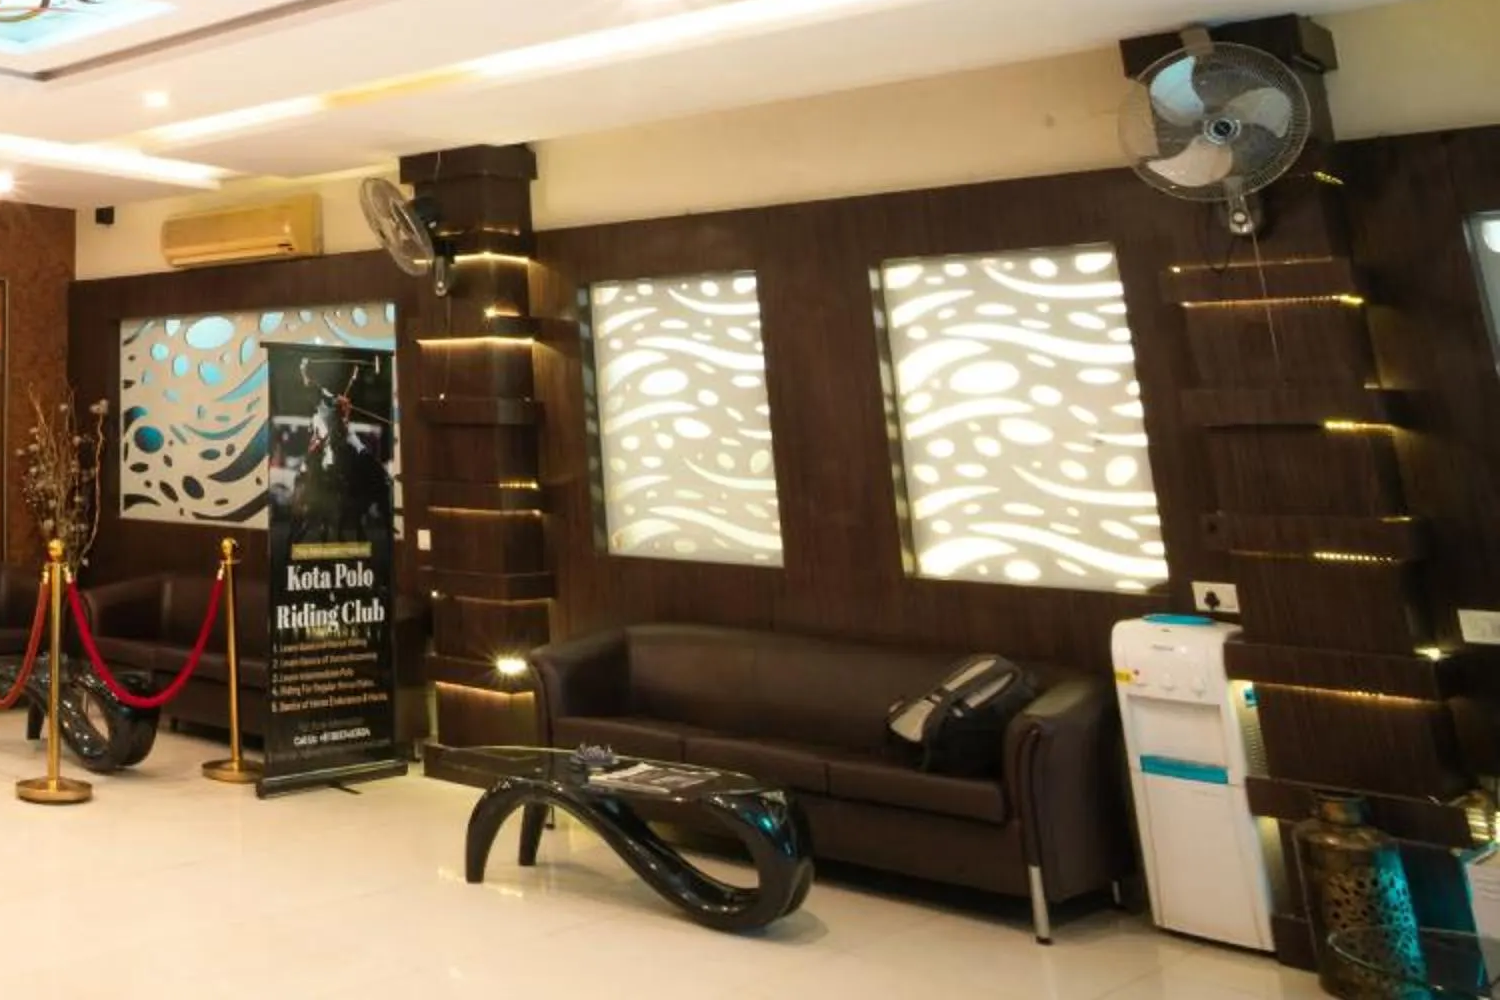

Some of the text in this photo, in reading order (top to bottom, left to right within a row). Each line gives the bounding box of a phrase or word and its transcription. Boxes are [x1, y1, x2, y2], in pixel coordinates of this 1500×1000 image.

[286, 560, 374, 591] Kota Polo
[276, 597, 385, 632] Riding Club
